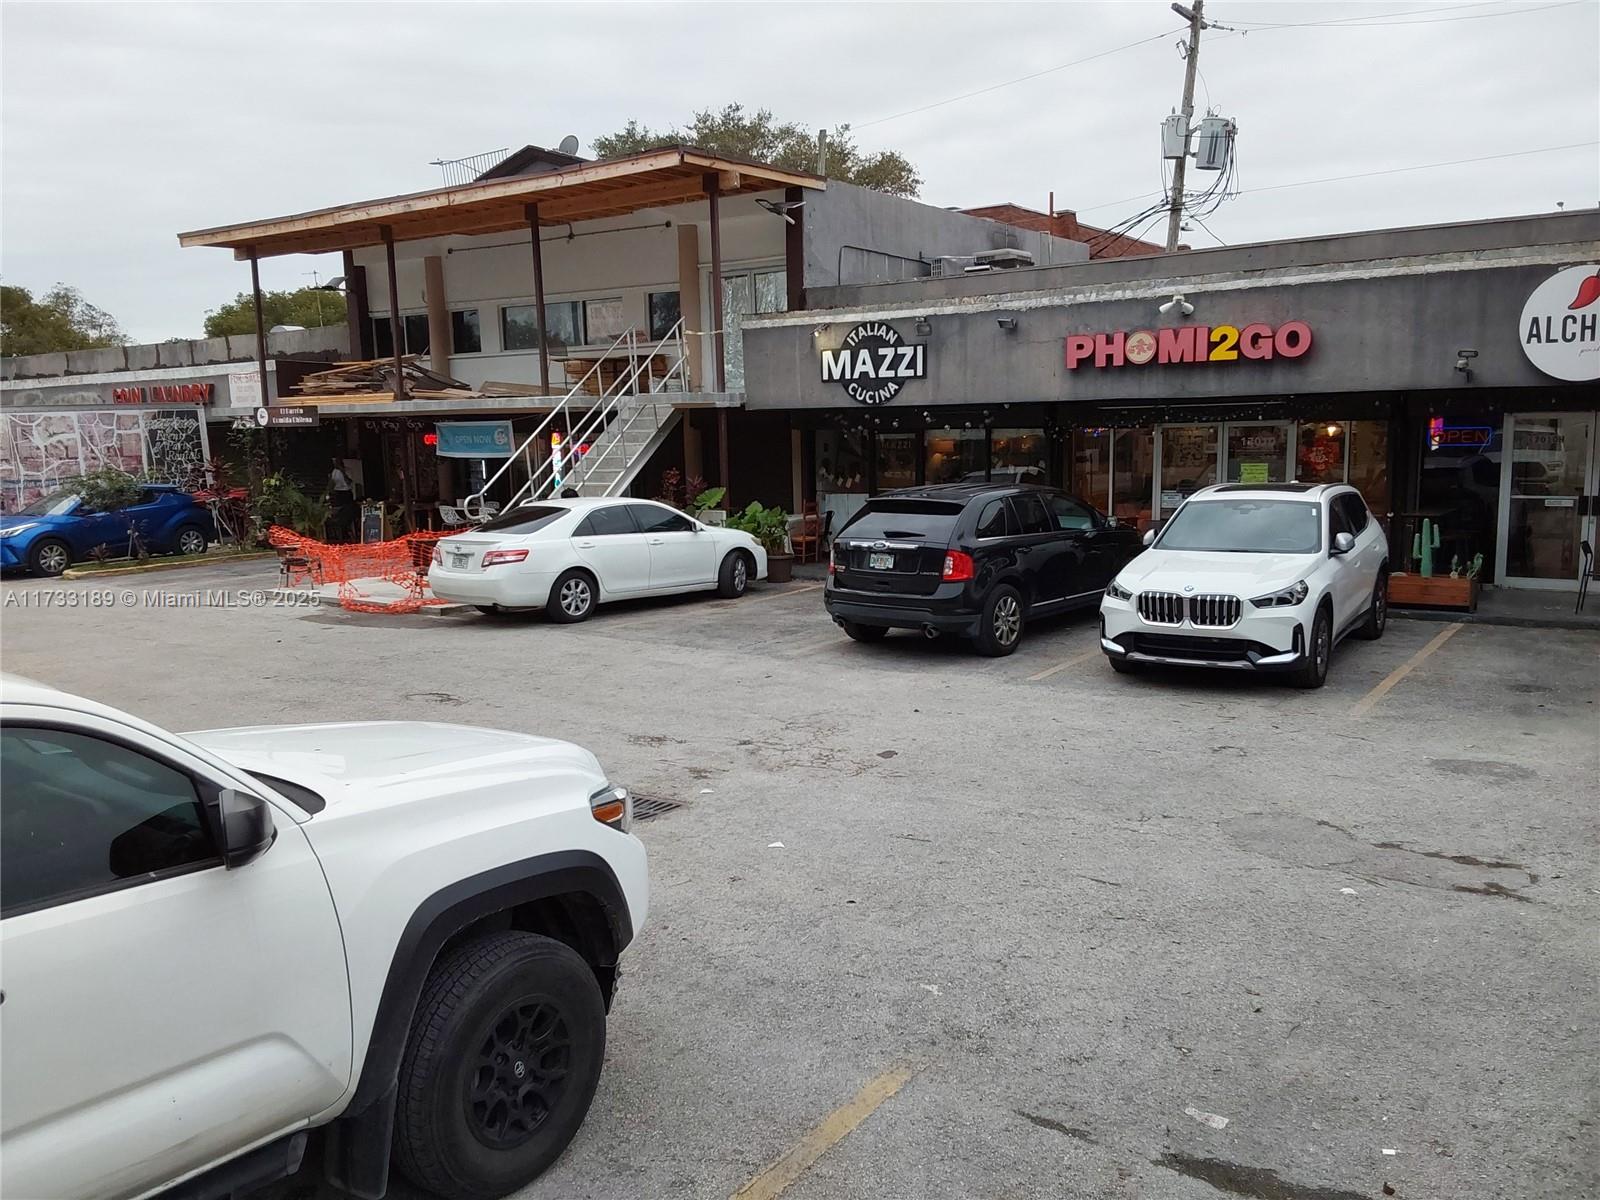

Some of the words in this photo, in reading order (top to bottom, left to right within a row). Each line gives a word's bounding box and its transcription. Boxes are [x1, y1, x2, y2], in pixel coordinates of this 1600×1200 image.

[846, 323, 898, 347] ITALIAN
[1526, 314, 1597, 344] ALCH
[1066, 320, 1312, 369] PHOMI2GO
[822, 345, 923, 380] MAZZI
[112, 386, 143, 404] COIN
[149, 383, 211, 403] LAUNDRY
[848, 381, 899, 404] CUCINA
[455, 435, 473, 443] OPEN
[473, 434, 491, 443] NOW
[1432, 429, 1490, 443] OPEN
